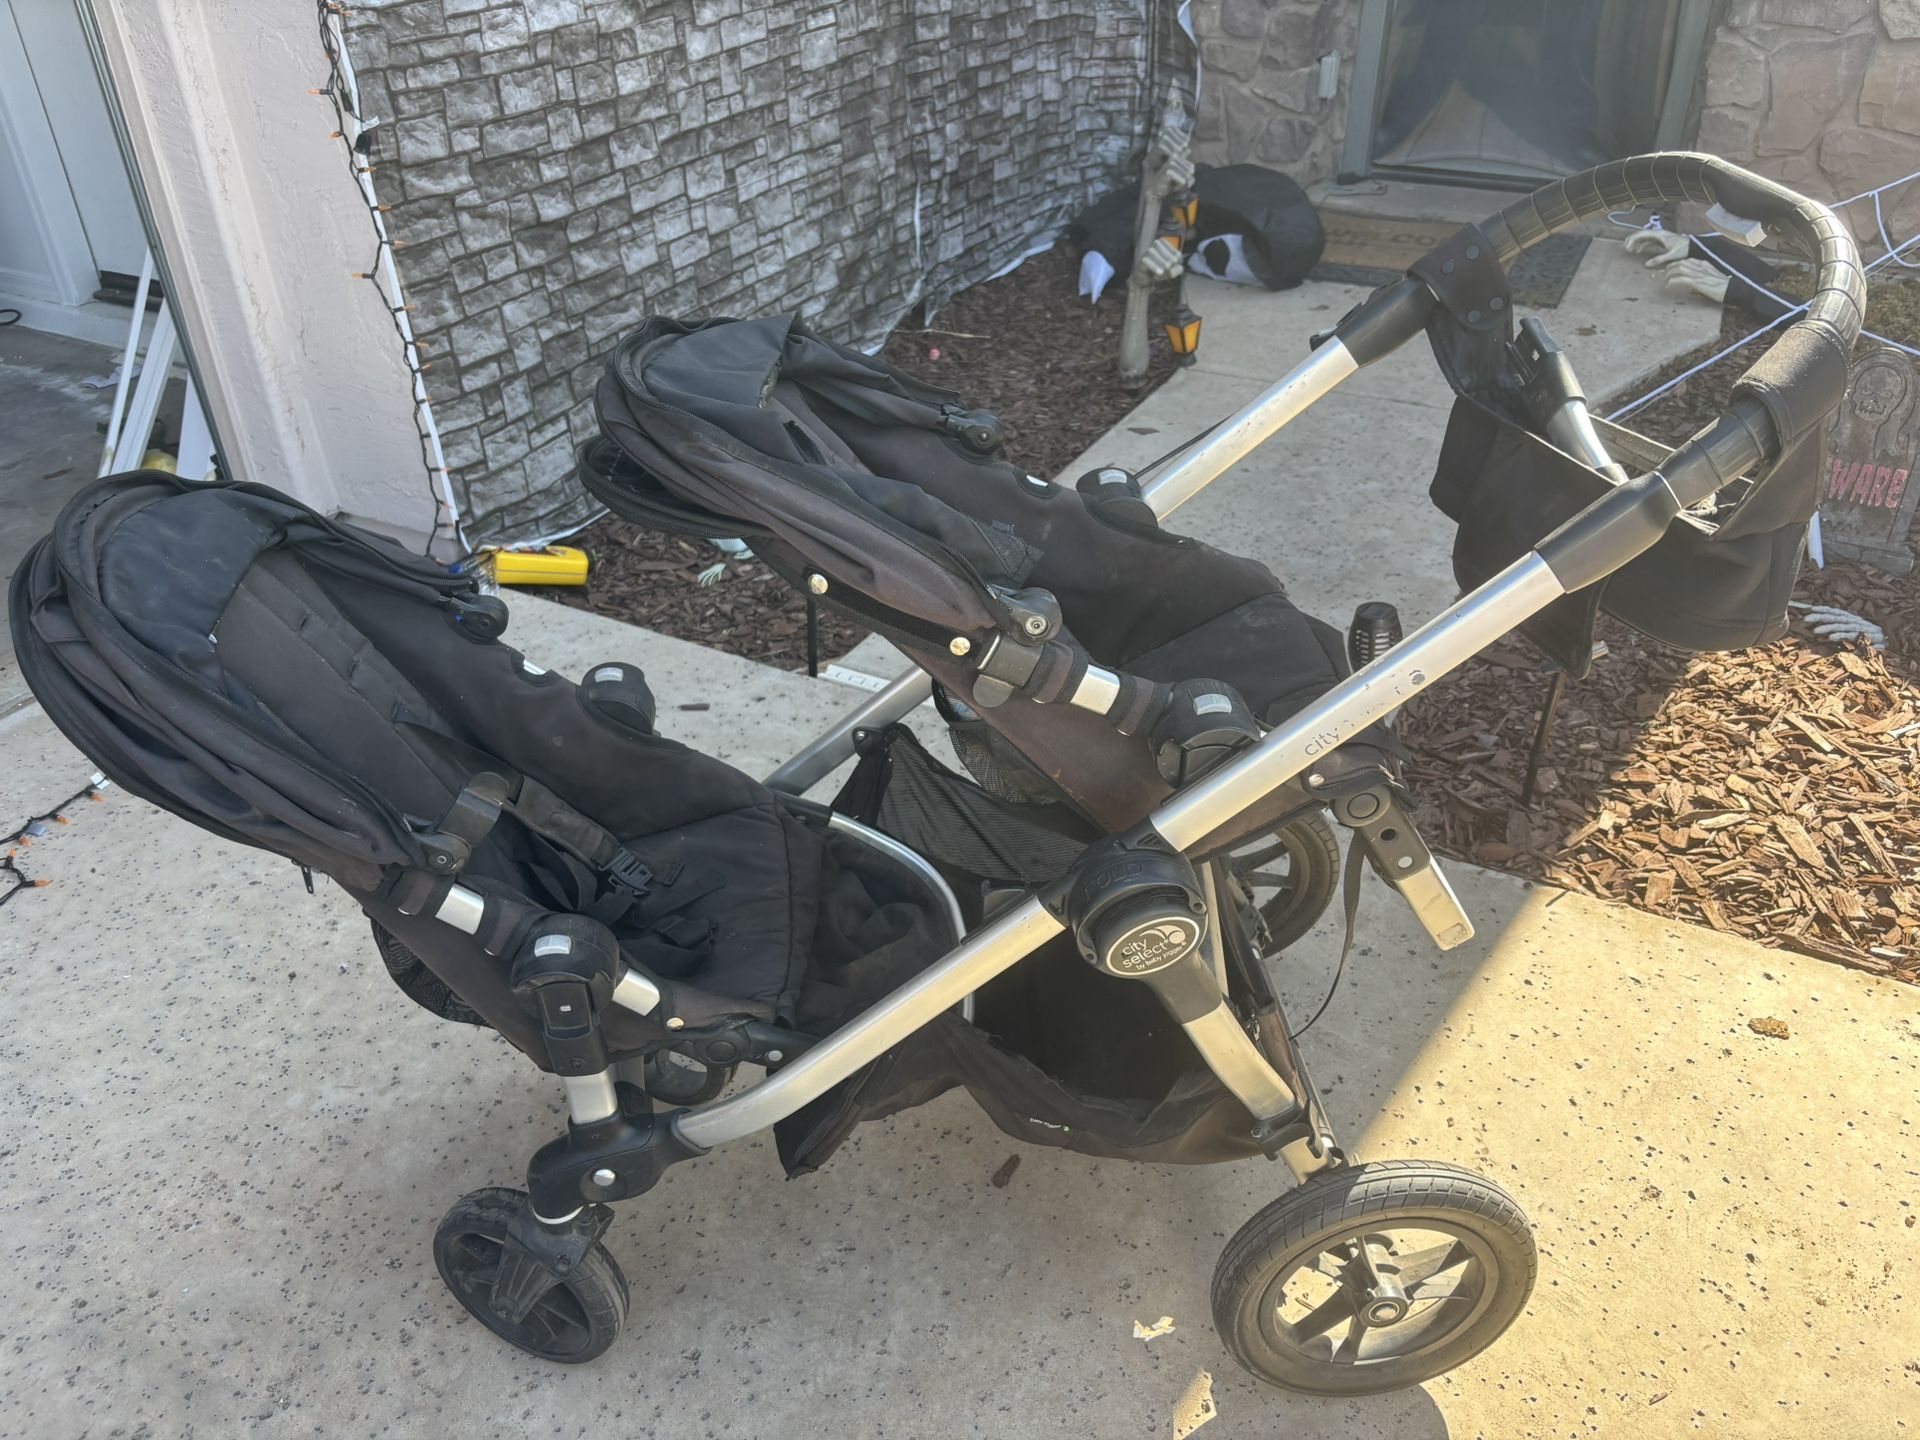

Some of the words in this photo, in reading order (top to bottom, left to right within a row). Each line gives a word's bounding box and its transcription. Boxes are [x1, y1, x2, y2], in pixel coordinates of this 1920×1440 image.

[1828, 458, 1908, 509] WARE
[1304, 727, 1340, 756] city
[1122, 938, 1147, 955] city
[1122, 941, 1168, 968] select
